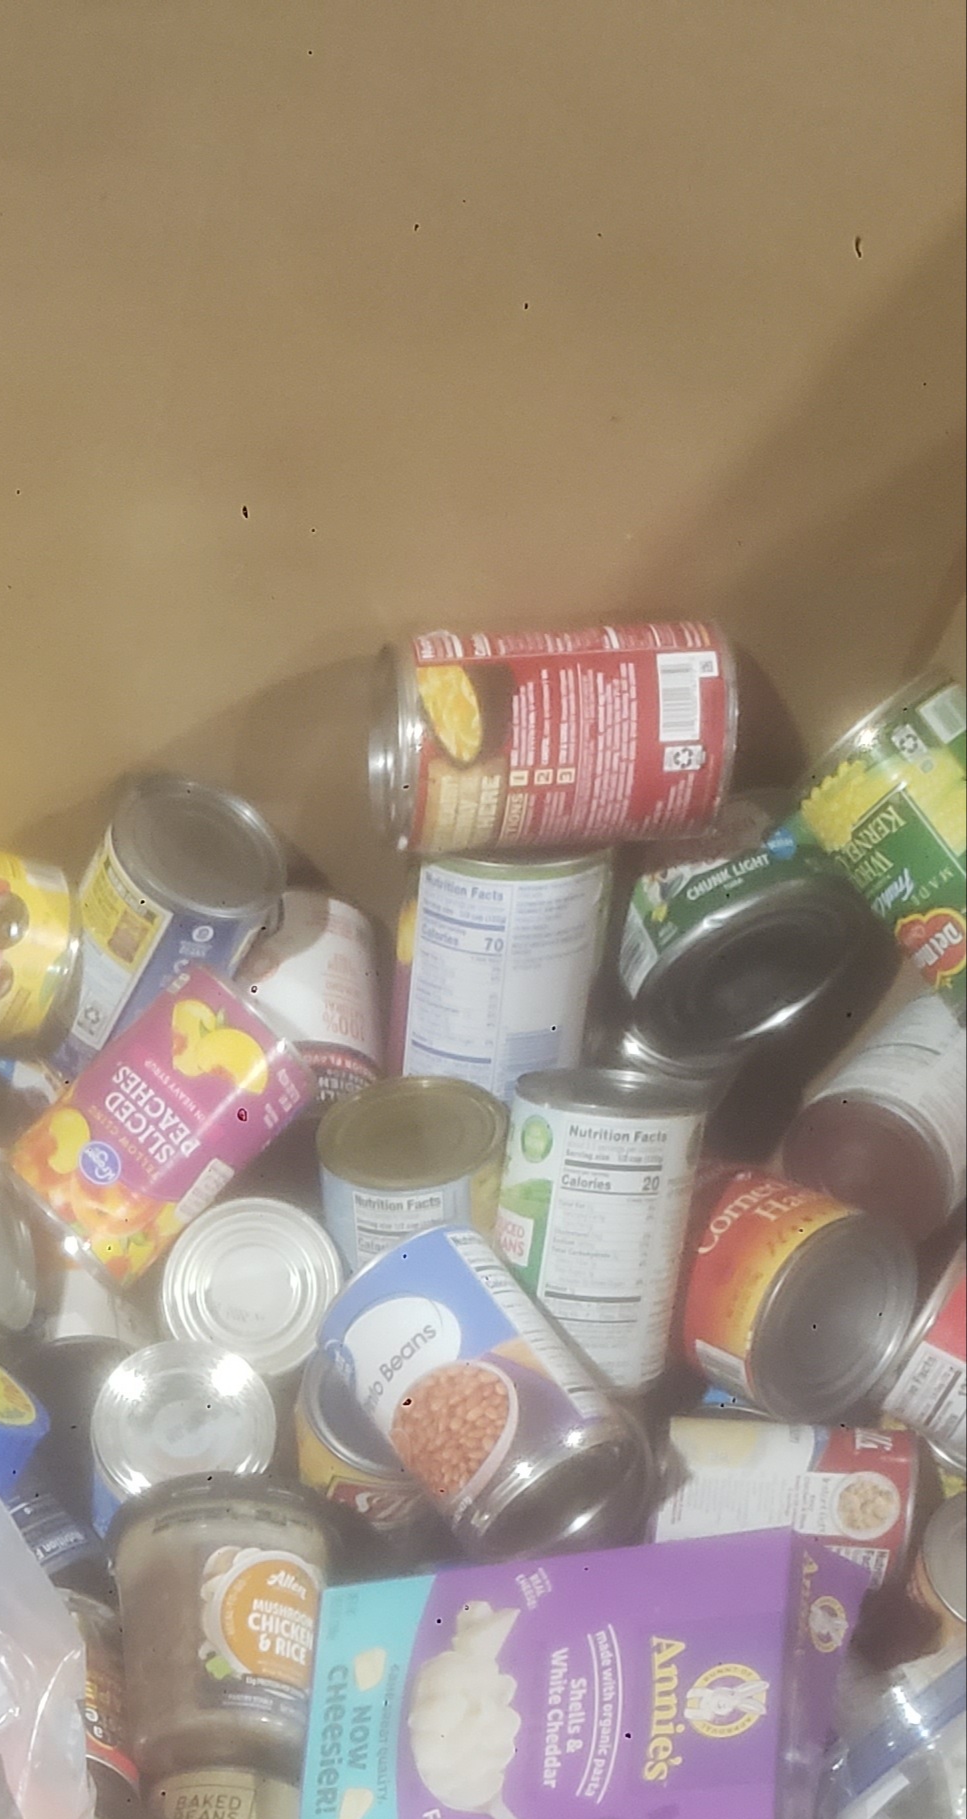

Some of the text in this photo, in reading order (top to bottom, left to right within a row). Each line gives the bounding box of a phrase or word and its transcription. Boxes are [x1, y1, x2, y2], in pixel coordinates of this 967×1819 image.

[425, 871, 505, 902] Nutrition Facts
[686, 853, 770, 901] CHUNK LIGHT
[852, 850, 895, 890] WHOL
[484, 936, 504, 952] 70
[104, 1091, 178, 1164] SLICED
[111, 1064, 202, 1158] PEACHES
[568, 1125, 668, 1143] Nutrition Facts
[355, 1193, 442, 1212] Nutrition Facts
[561, 1174, 660, 1192] Calories 20
[753, 1191, 800, 1223] Ha
[379, 1323, 437, 1383] Beans
[247, 1611, 314, 1651] CHICKEN
[275, 1637, 308, 1666] RICE
[542, 1646, 570, 1789] White Cheddar
[566, 1677, 588, 1754] Shells &
[584, 1630, 616, 1797] made with organic pasta
[643, 1634, 687, 1783] Annie's
[347, 1703, 372, 1771] NOW
[175, 1793, 243, 1812] BAKED
